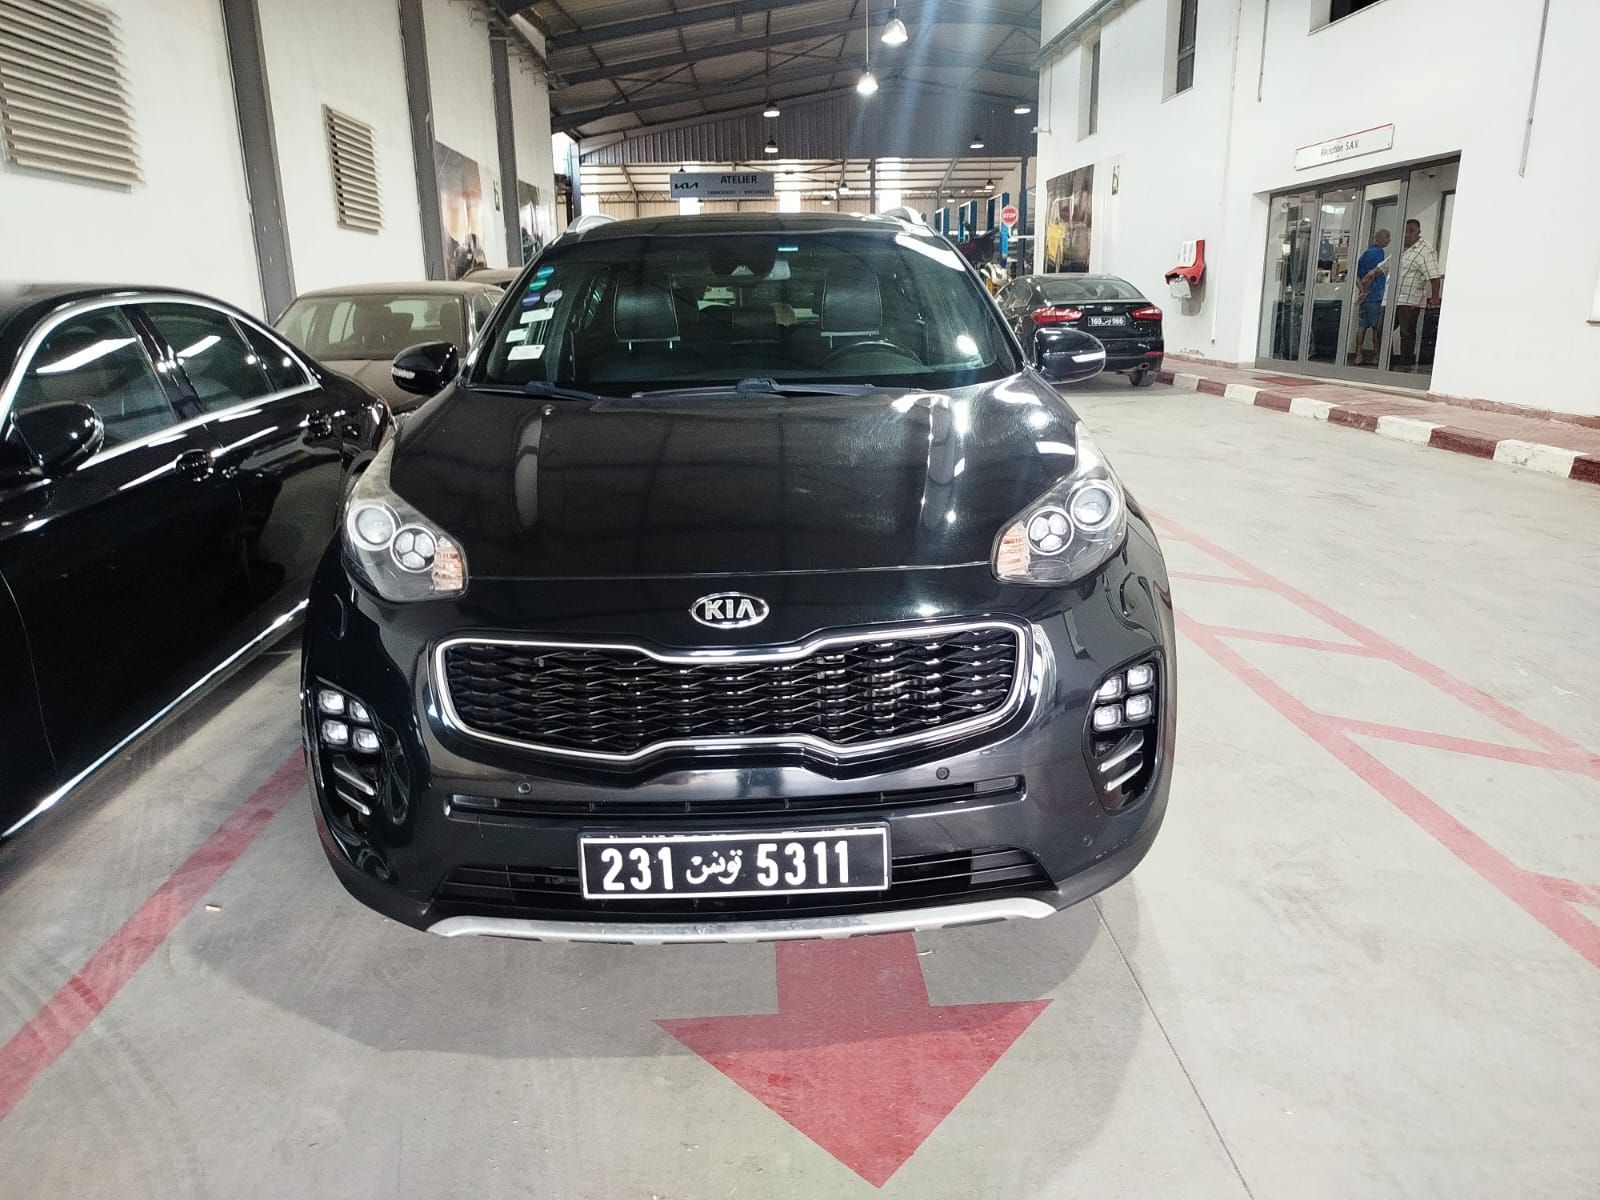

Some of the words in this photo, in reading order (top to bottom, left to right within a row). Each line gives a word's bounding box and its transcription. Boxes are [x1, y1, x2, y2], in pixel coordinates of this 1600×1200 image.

[720, 175, 758, 185] ATELIER
[704, 598, 756, 620] KIA
[600, 846, 674, 891] 231
[685, 848, 744, 885] تونس
[756, 840, 850, 887] 5311
